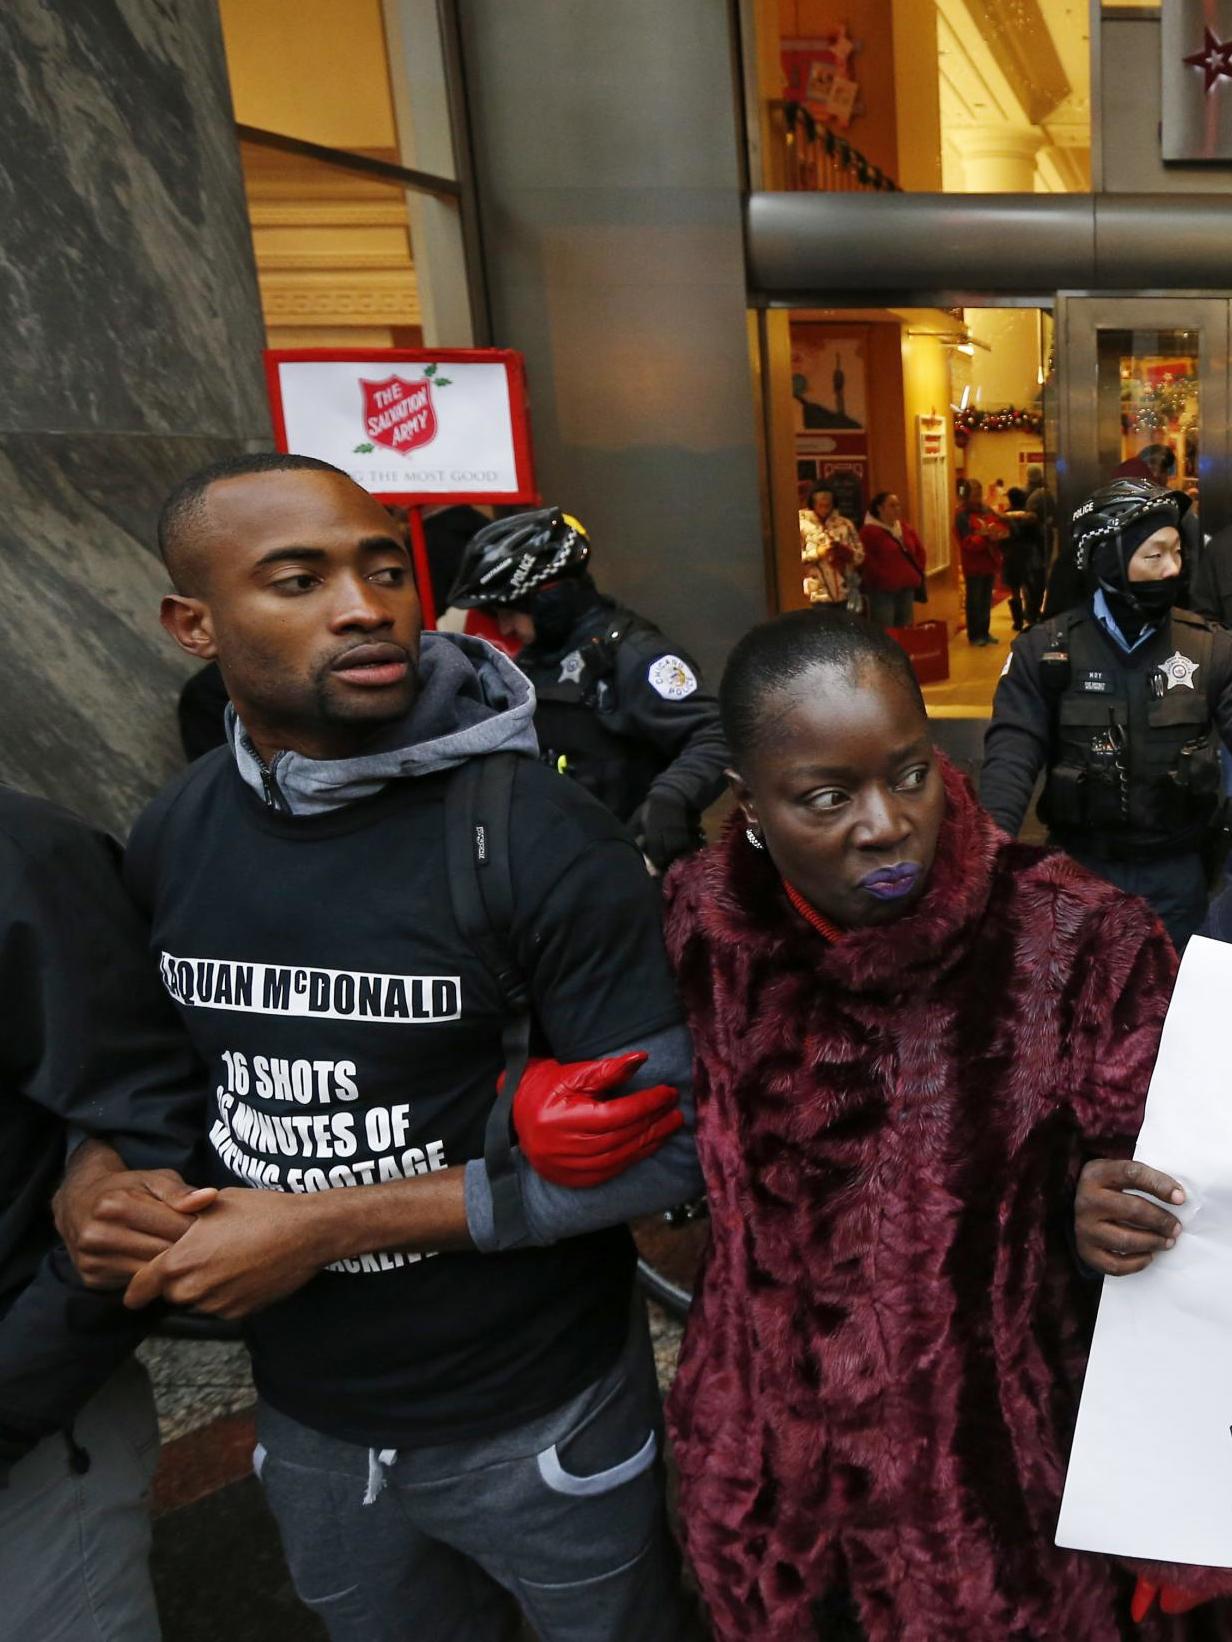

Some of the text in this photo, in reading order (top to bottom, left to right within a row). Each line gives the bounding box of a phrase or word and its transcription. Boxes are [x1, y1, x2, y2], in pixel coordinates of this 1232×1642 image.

[367, 388, 428, 437] SALVATION
[373, 382, 403, 408] THE
[392, 410, 429, 446] ARMY
[369, 471, 399, 481] THE
[404, 471, 446, 481] MOST
[451, 471, 499, 481] GOOD
[1072, 501, 1095, 521] POLICE
[510, 553, 537, 588] POLICE
[221, 1050, 359, 1104] 16 SHOTS
[232, 1101, 358, 1159] MINUTES
[365, 1104, 411, 1153] OF
[287, 1140, 449, 1194] FOOTAGE
